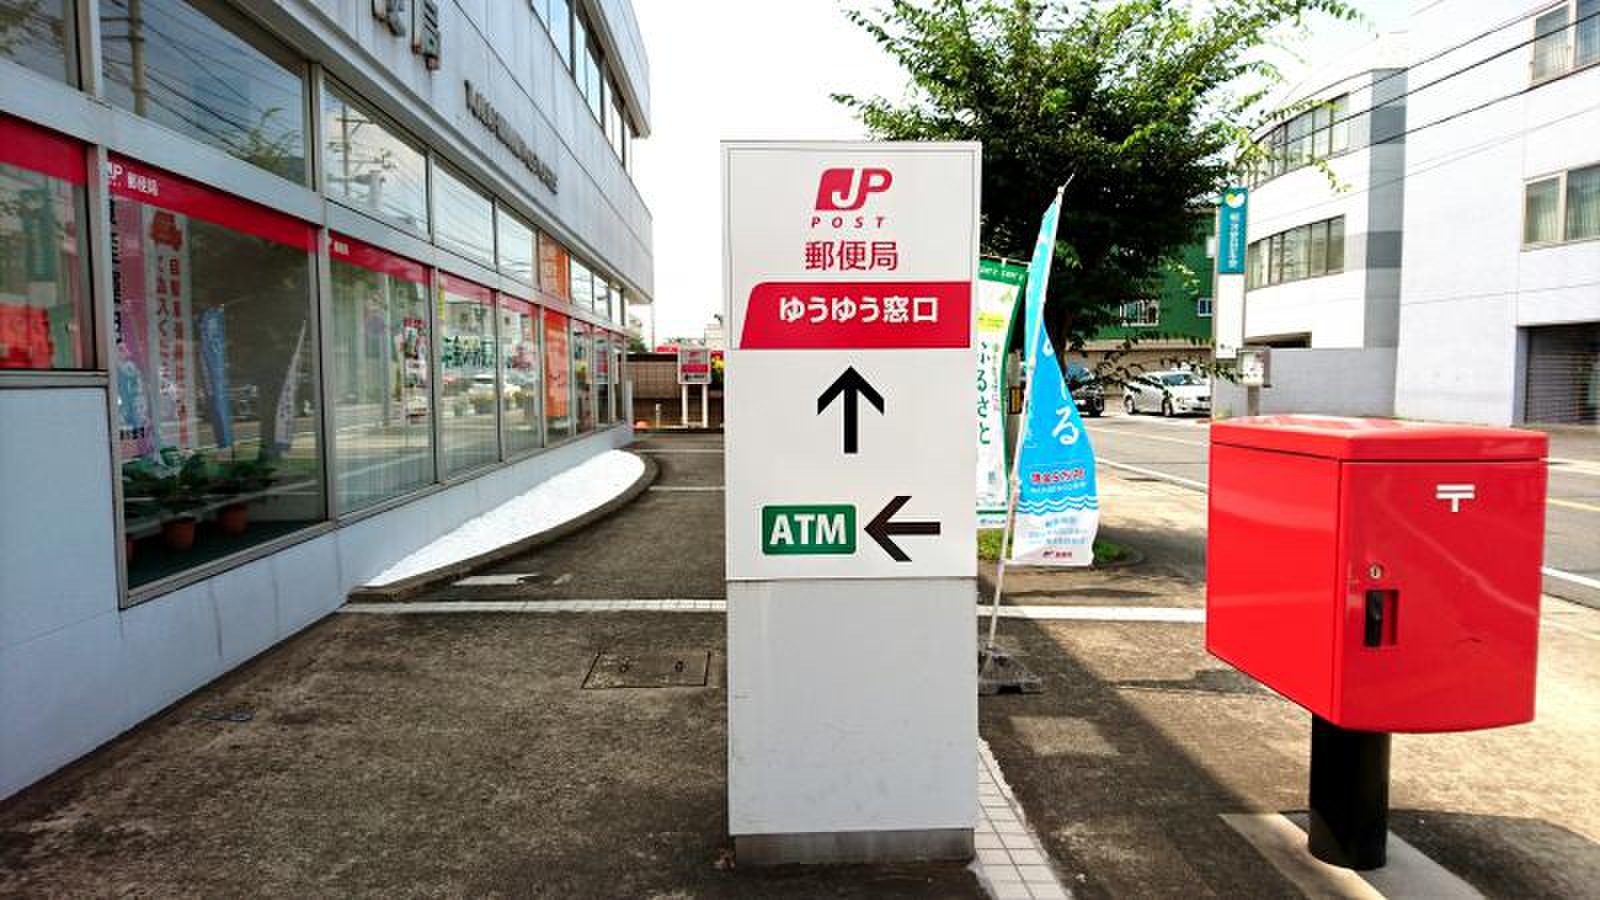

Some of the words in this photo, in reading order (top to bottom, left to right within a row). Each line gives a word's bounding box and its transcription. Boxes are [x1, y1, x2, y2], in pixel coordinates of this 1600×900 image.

[815, 168, 893, 211] JP
[810, 216, 885, 229] POST
[805, 240, 899, 271] 郵便局
[779, 296, 939, 323] ゆうゆう窓口
[769, 512, 848, 546] ATM
